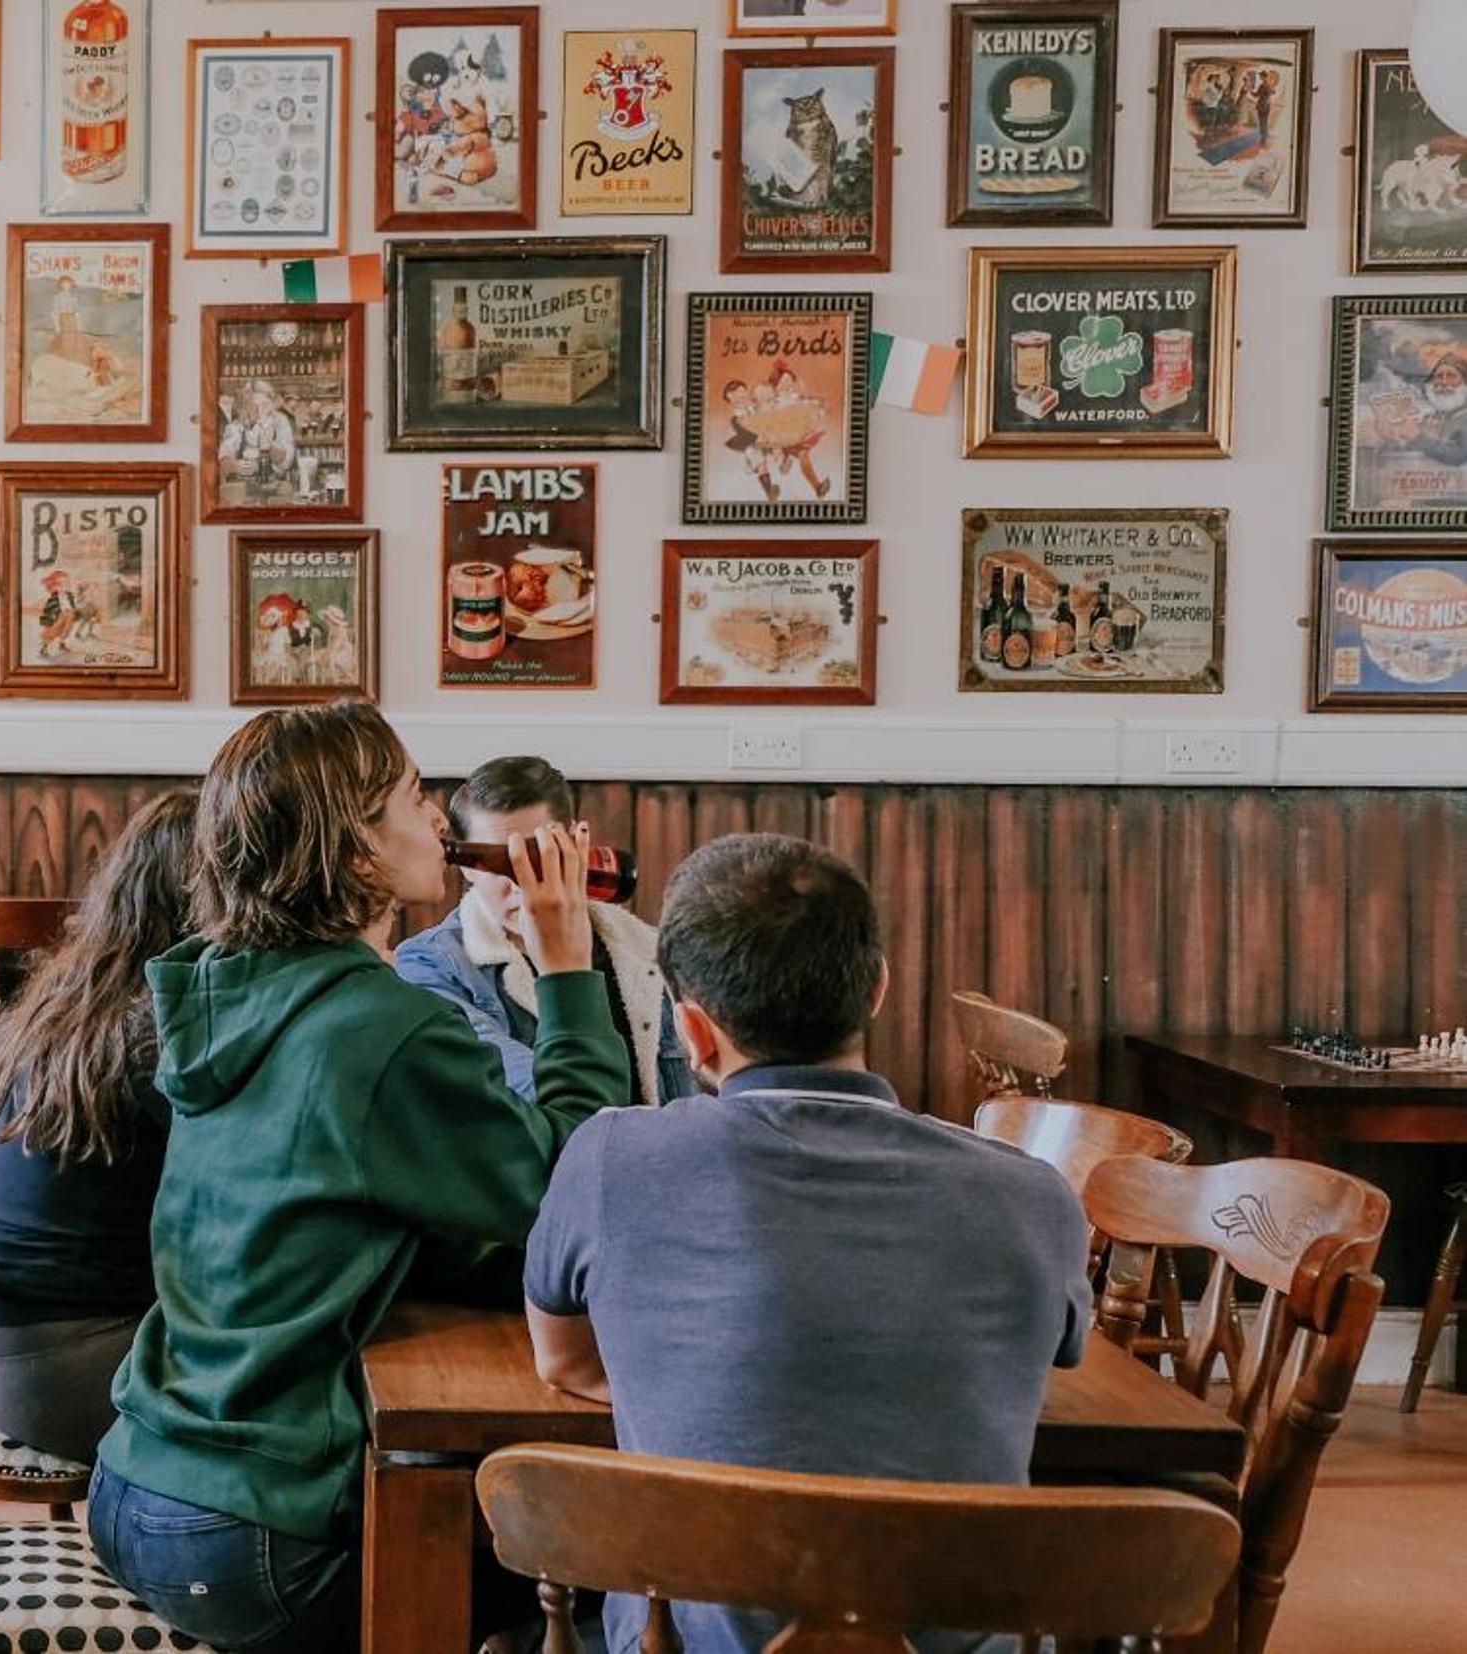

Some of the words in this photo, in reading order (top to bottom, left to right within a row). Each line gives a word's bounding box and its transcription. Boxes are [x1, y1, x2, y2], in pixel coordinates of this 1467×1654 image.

[74, 46, 116, 58] PADDY
[570, 129, 684, 180] Beck's
[975, 143, 1087, 172] BREAD
[603, 179, 650, 190] BEER
[478, 283, 534, 301] CORK
[1011, 292, 1091, 313] CLOVER
[1096, 290, 1162, 313] MEATS,
[479, 288, 587, 325] DISTILLERIES
[493, 326, 572, 339] WHISKY
[757, 329, 842, 356] Bird's
[1064, 338, 1142, 369] Clover
[1055, 409, 1150, 421] WATERFORD.
[478, 511, 549, 536] JAM
[32, 501, 148, 572] BISTO
[1041, 525, 1139, 547] WHITAKER
[1146, 529, 1159, 547] &
[254, 552, 354, 566] NUGGET
[1043, 552, 1114, 566] BREWERS
[686, 561, 703, 576] W
[717, 561, 732, 576] R
[728, 560, 791, 582] JACOB
[1151, 604, 1212, 622] BRADFORD
[1429, 600, 1467, 628] MUS
